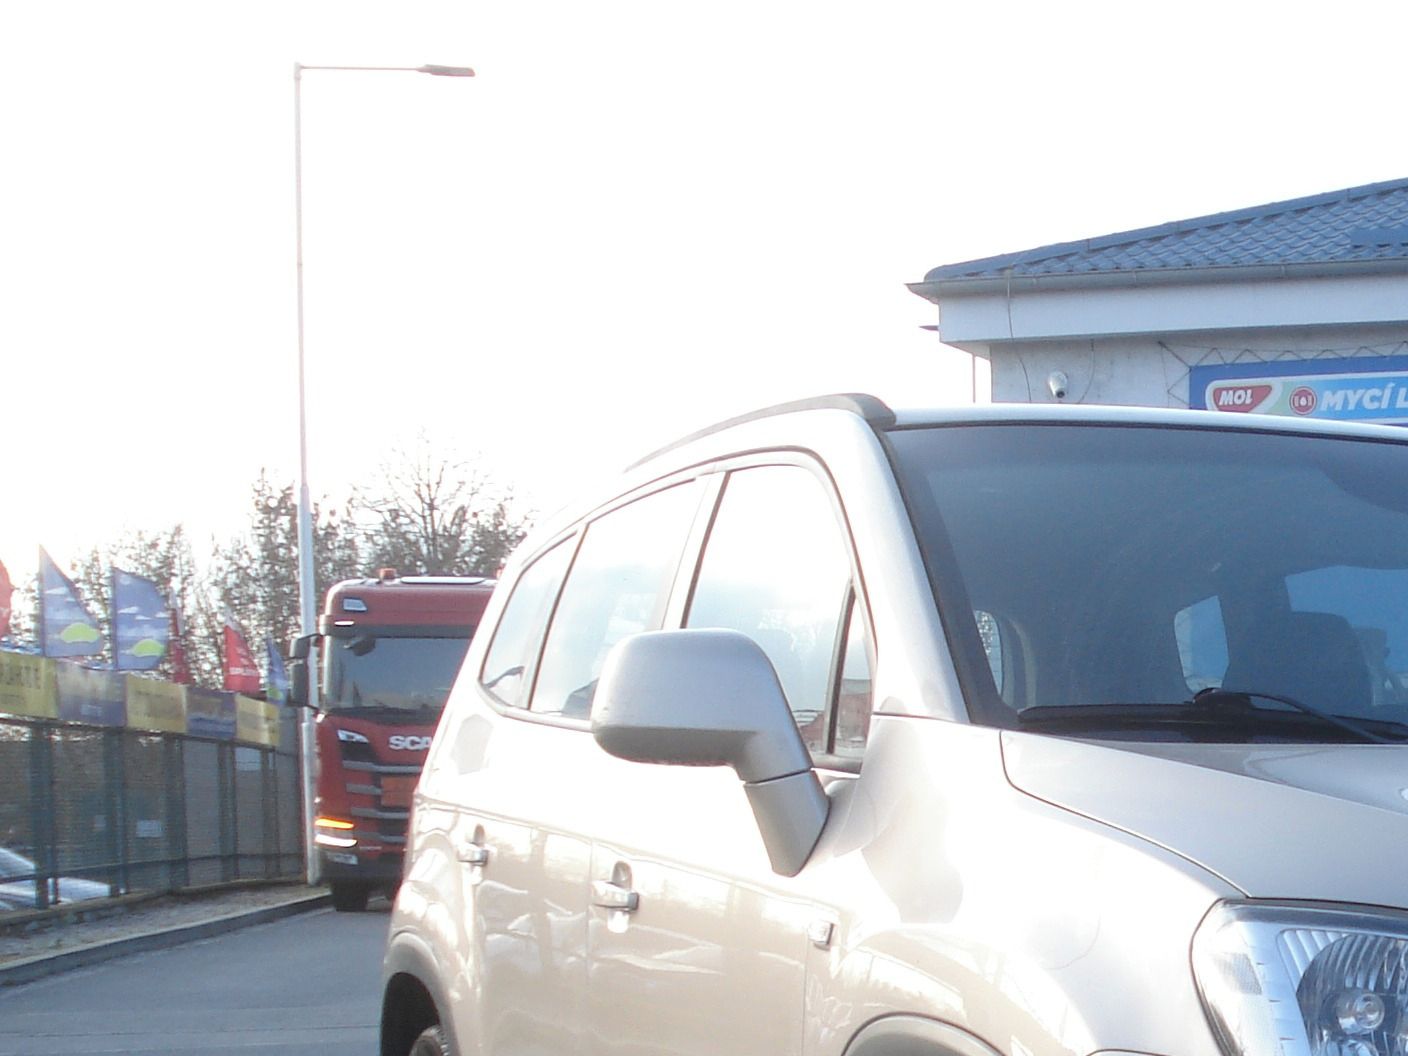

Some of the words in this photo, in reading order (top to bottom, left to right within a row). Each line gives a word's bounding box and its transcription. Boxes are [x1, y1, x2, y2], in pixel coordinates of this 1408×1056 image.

[1218, 388, 1253, 406] MOL
[1319, 382, 1397, 411] MYCÍ
[389, 735, 433, 750] SCA
